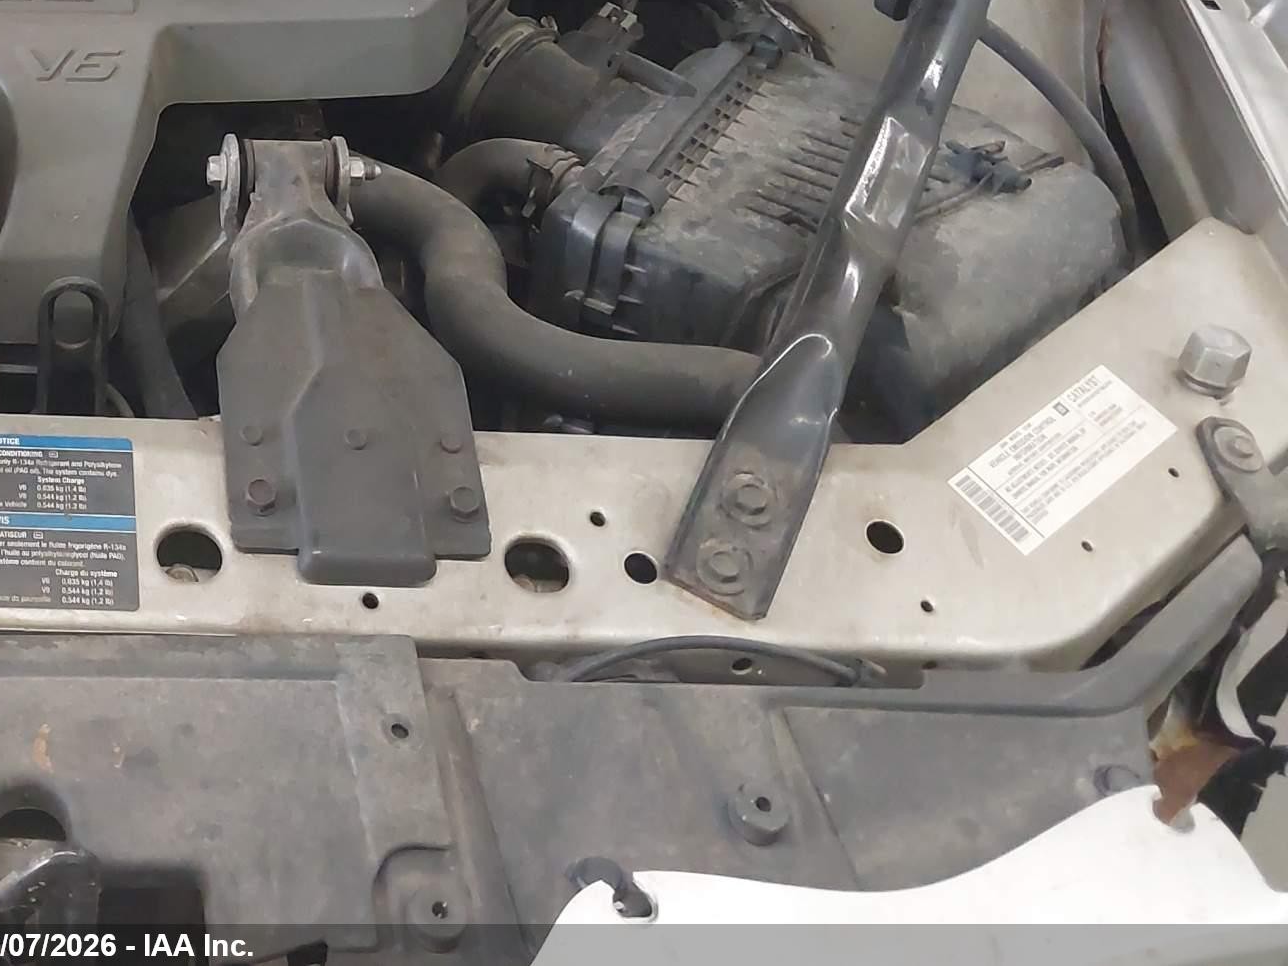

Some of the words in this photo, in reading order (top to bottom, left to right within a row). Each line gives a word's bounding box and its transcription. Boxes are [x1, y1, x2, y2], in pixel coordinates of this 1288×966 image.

[29, 48, 126, 83] V6
[1065, 374, 1102, 403] CATALYST
[55, 569, 78, 577] Charge
